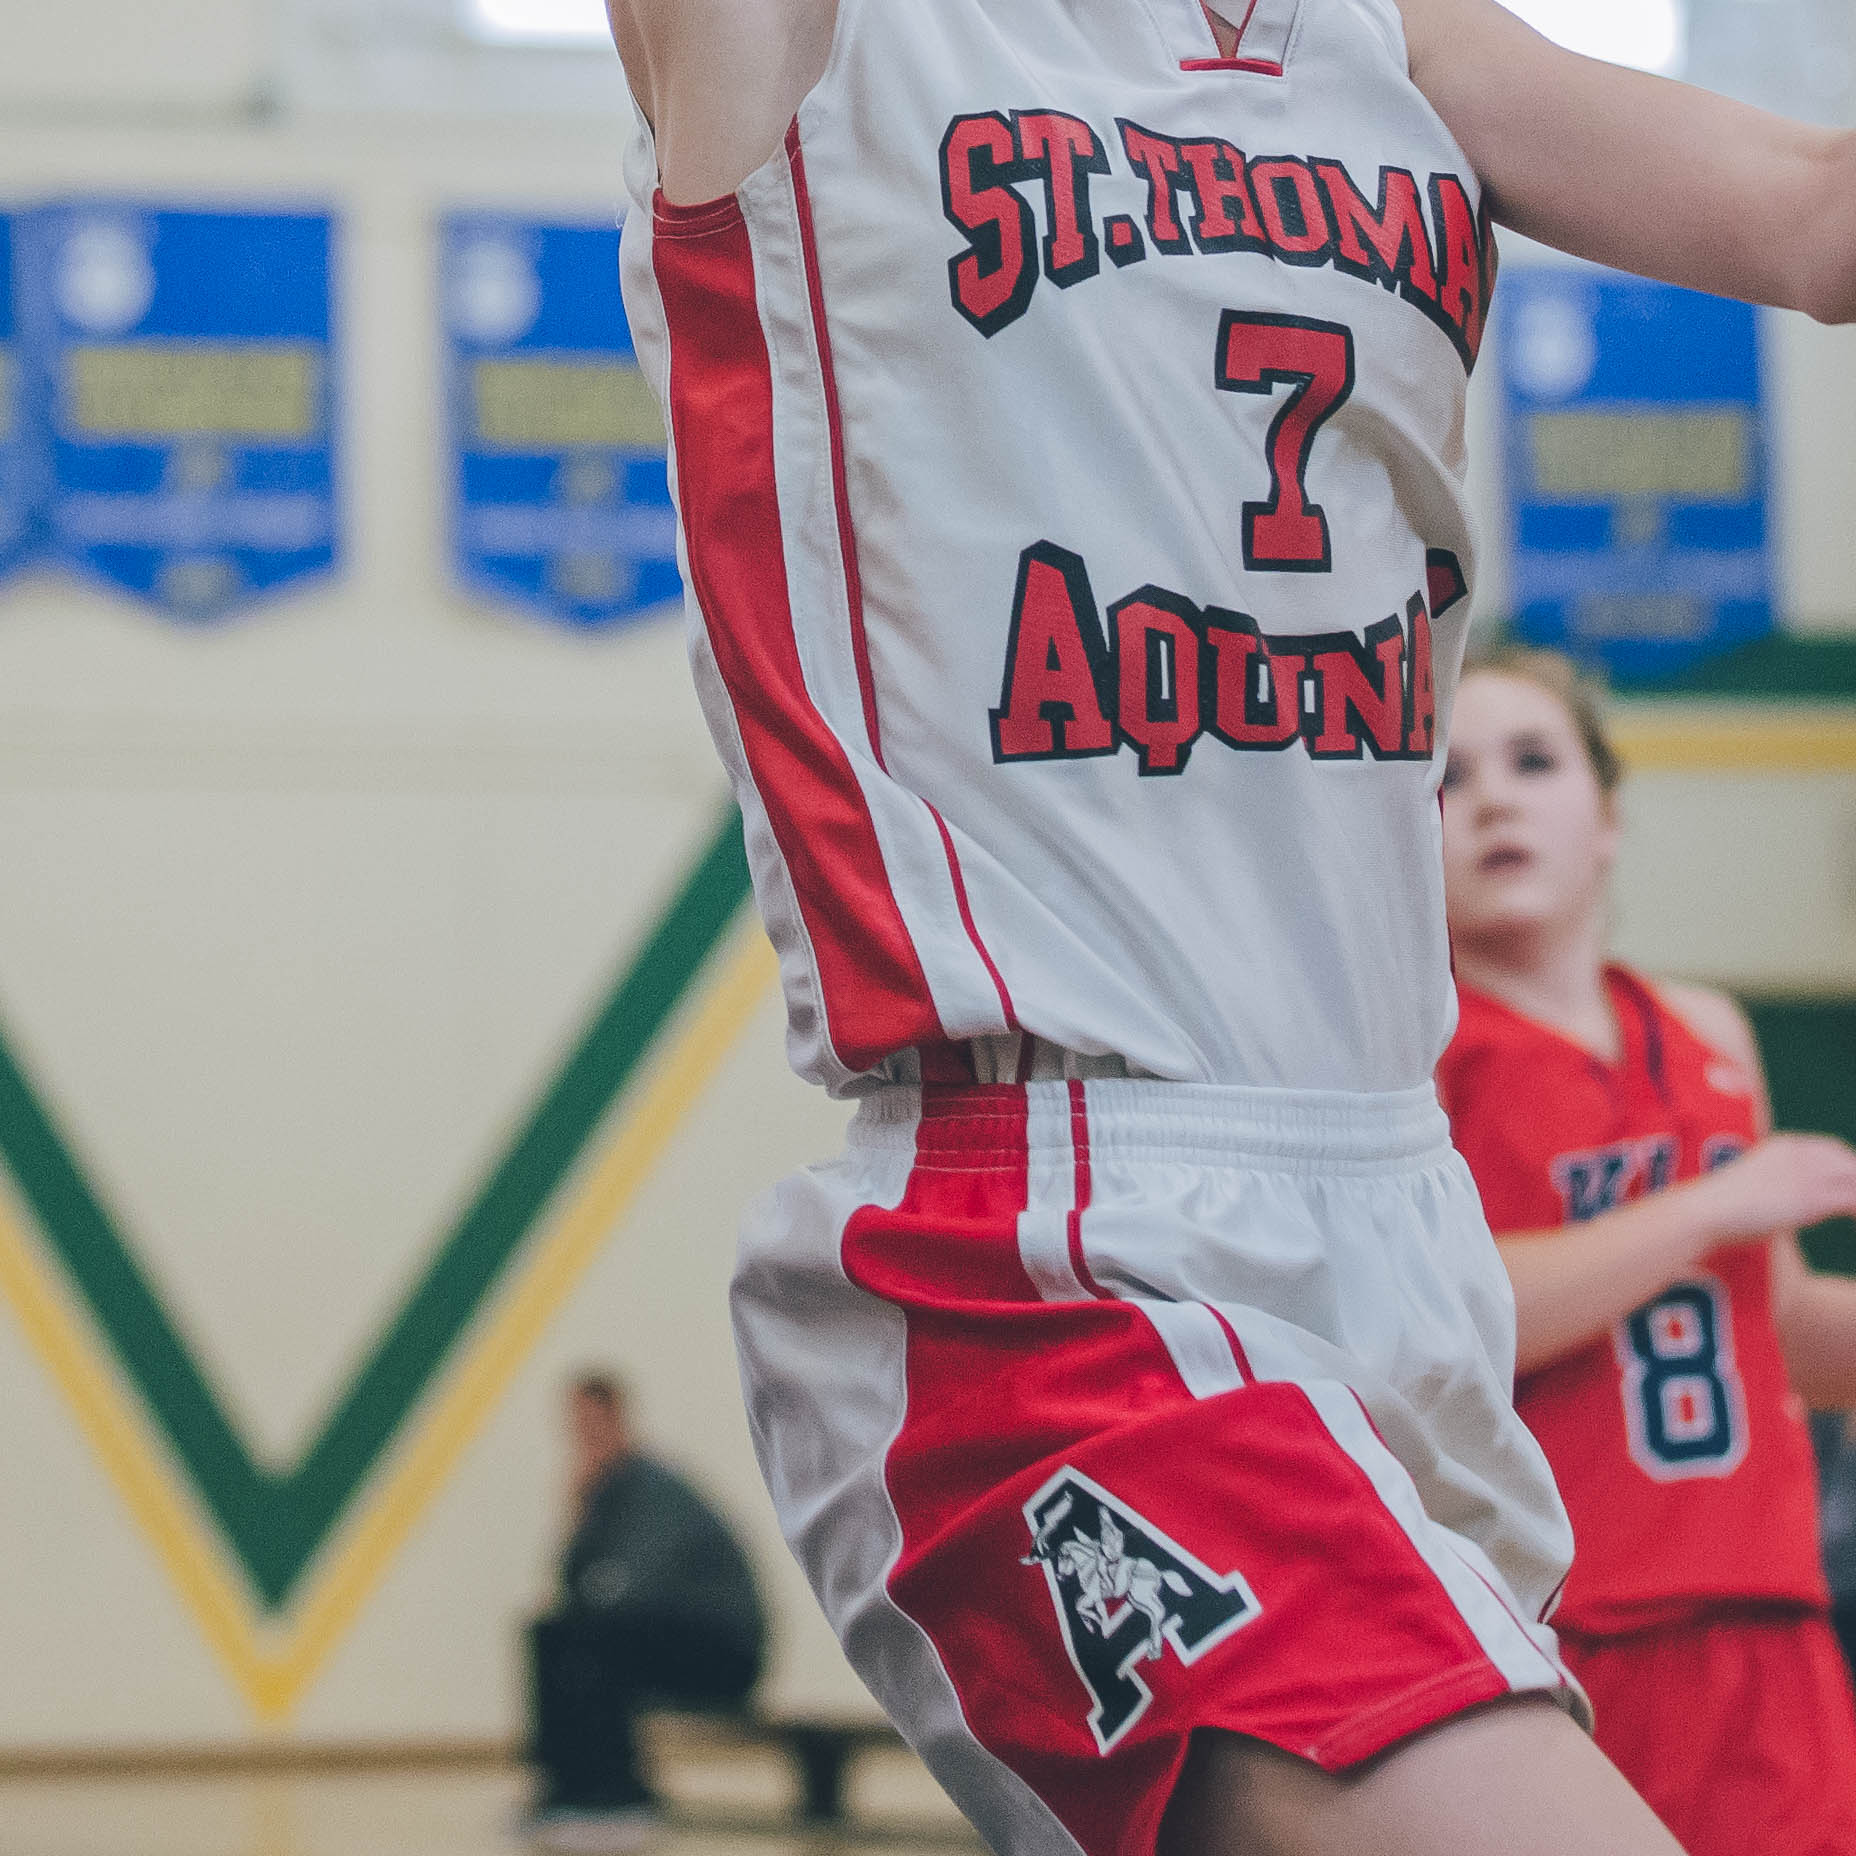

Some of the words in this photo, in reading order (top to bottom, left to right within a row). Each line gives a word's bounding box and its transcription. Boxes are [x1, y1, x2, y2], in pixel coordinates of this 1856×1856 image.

[939, 108, 1494, 377] ST.THOMA
[1215, 309, 1355, 572] 7
[1616, 1277, 1748, 1482] 8
